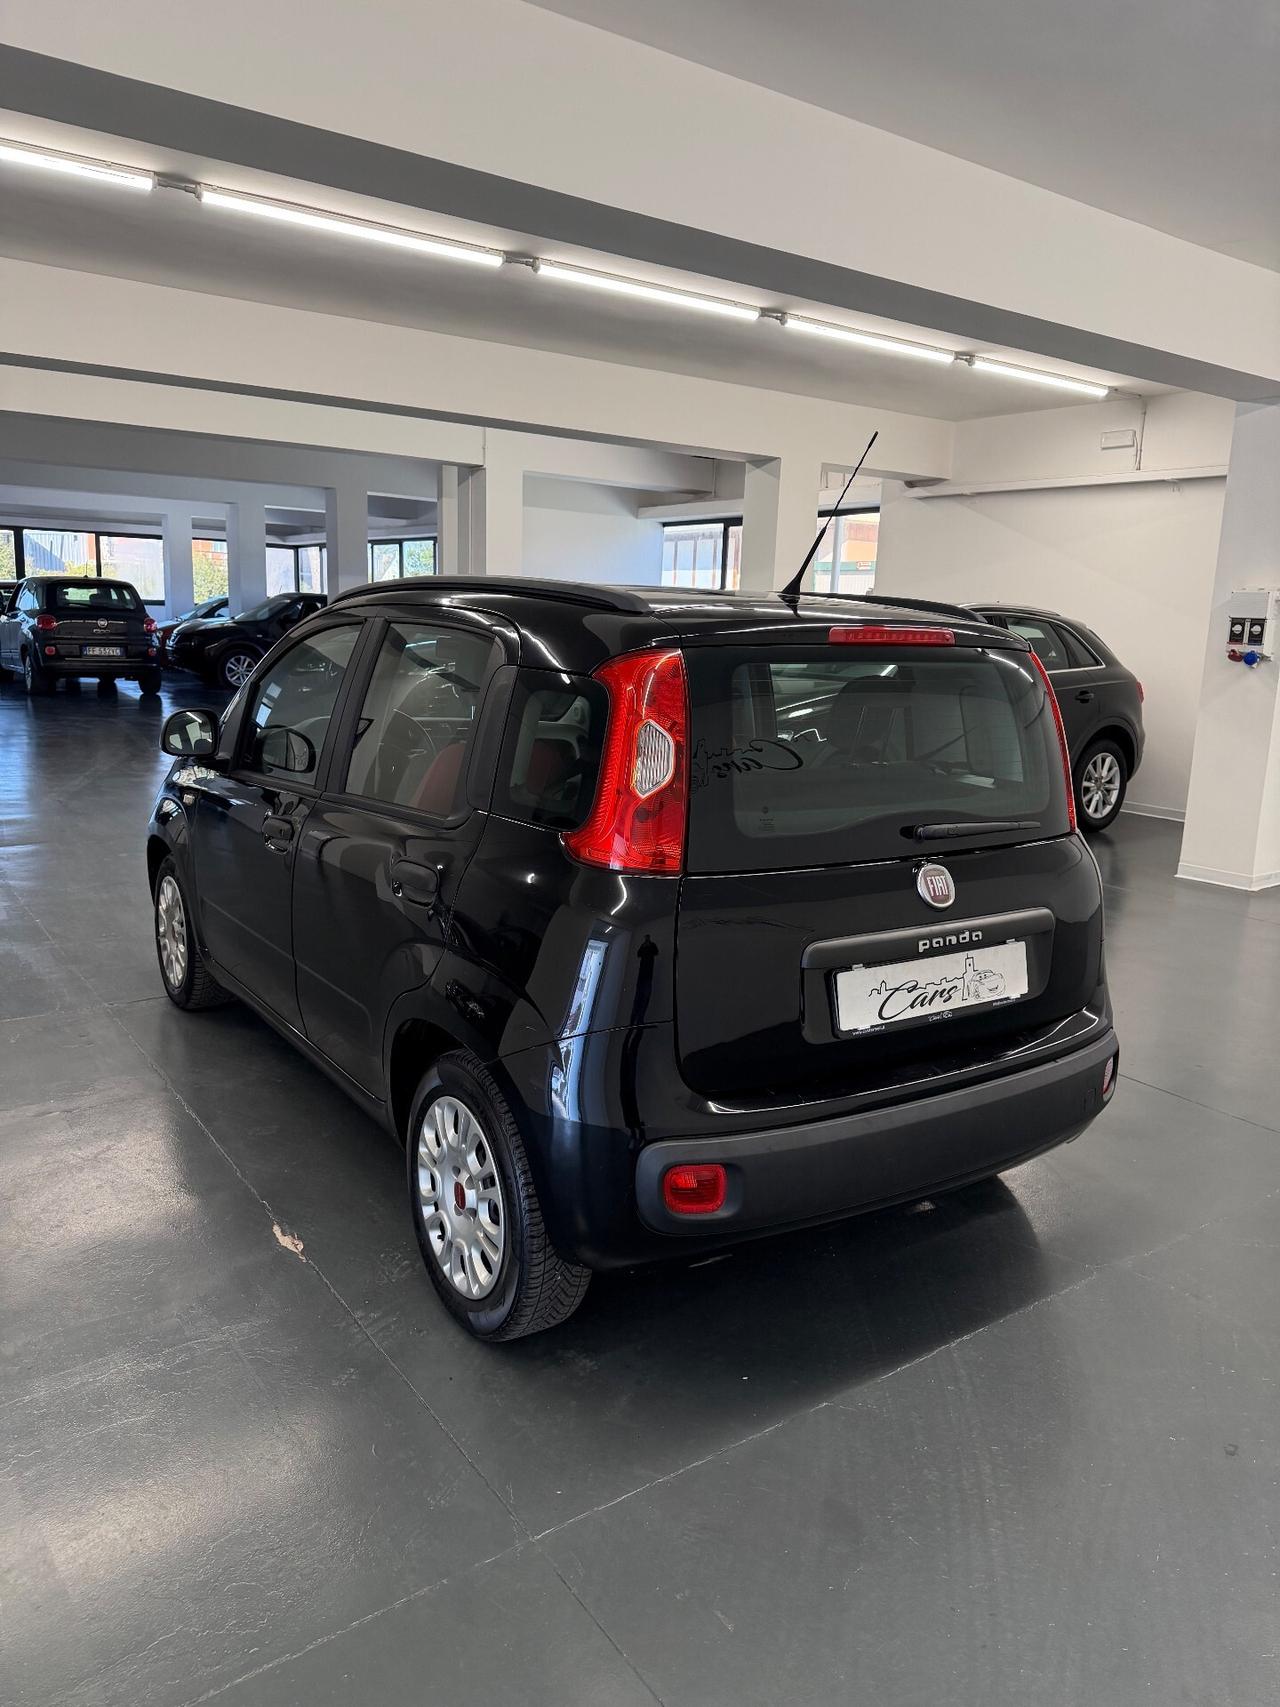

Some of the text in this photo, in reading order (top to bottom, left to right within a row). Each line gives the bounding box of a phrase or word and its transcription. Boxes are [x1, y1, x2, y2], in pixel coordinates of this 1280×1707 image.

[926, 875, 948, 897] FIAT
[918, 929, 983, 953] panda
[877, 979, 961, 1020] Cars
